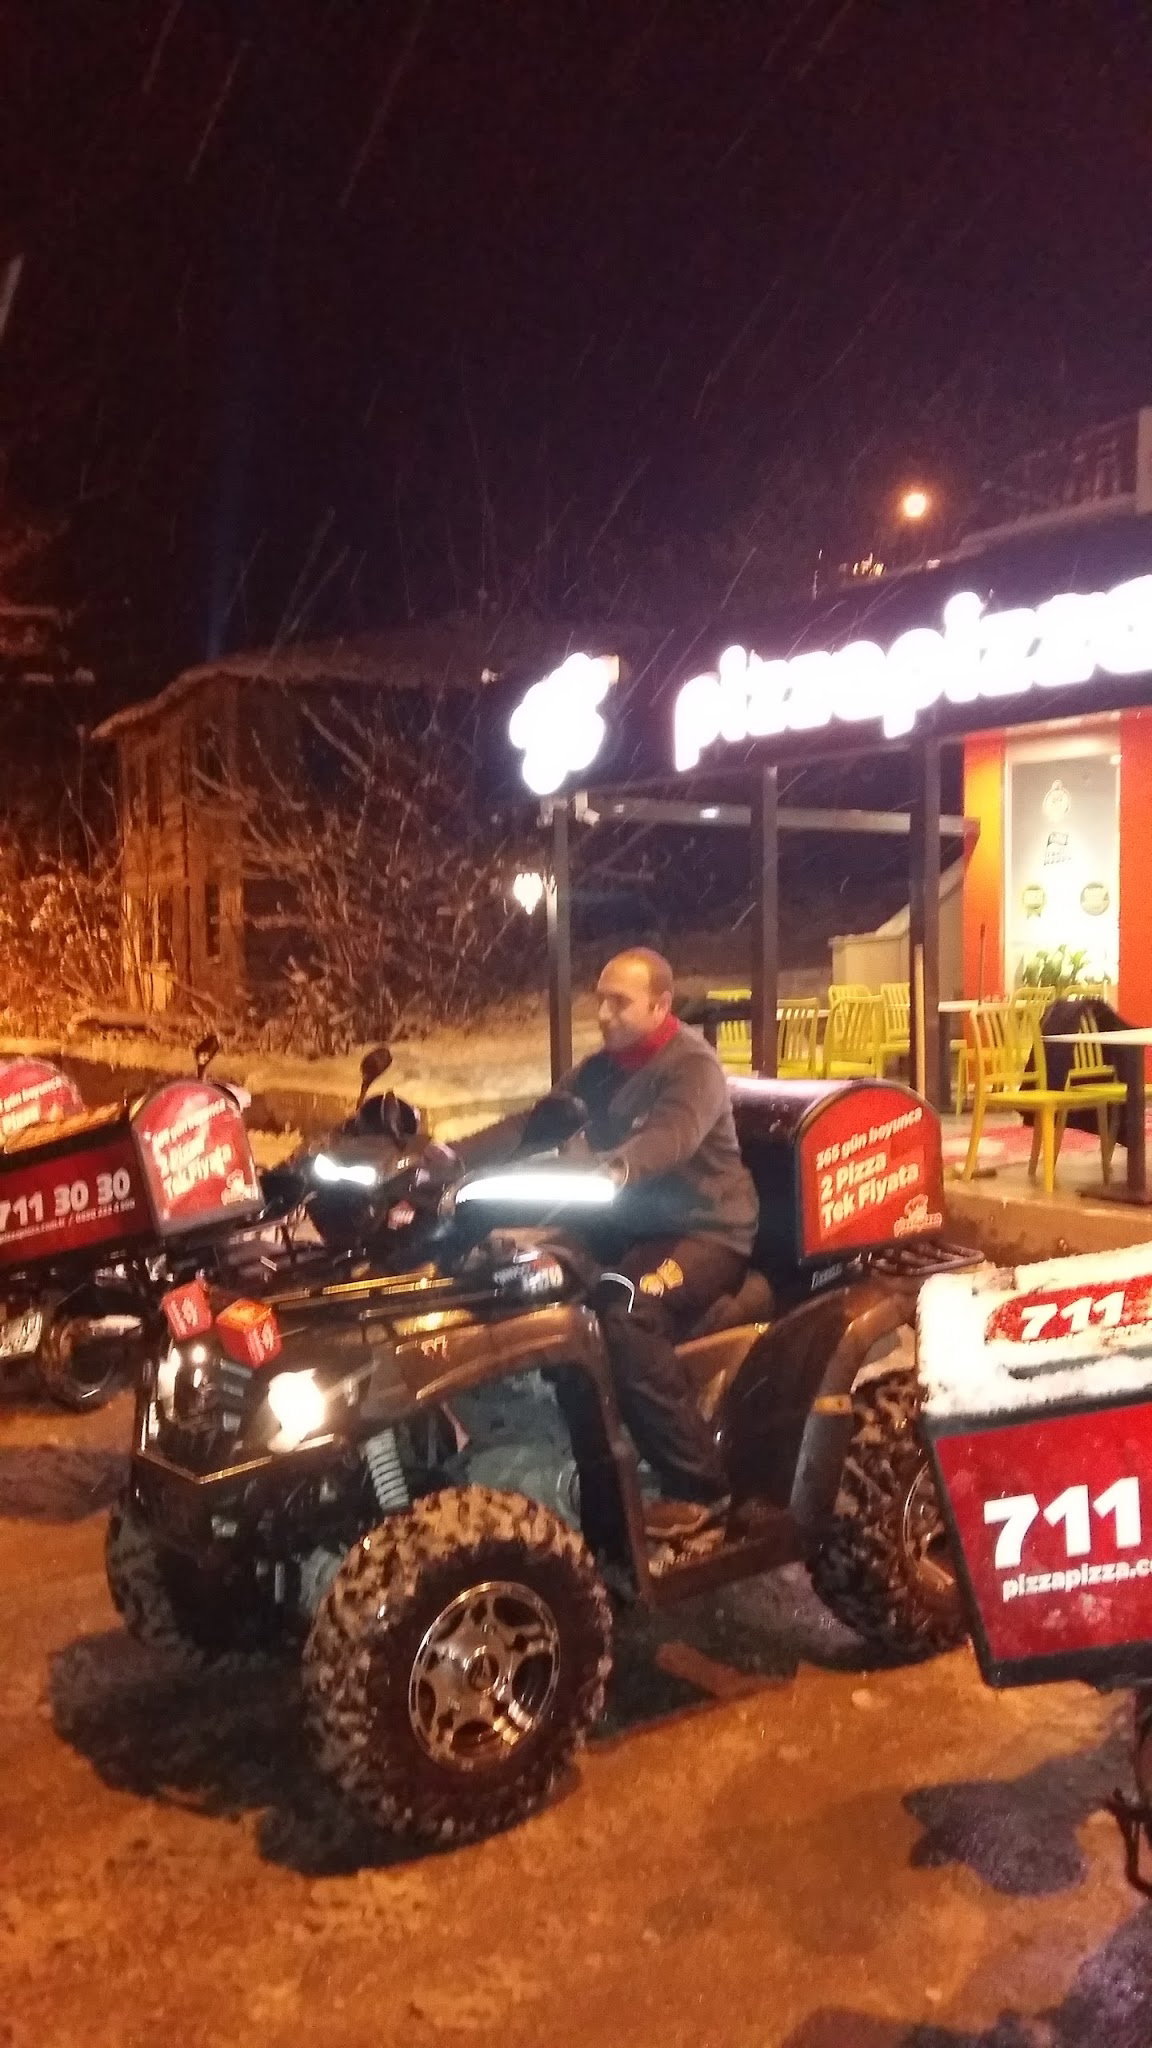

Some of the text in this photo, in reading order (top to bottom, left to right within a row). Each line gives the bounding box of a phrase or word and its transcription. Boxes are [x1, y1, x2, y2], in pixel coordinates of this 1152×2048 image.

[816, 1107, 923, 1171] 365 gün boyunca
[54, 1180, 89, 1216] 30
[96, 1168, 131, 1205] 30
[820, 1151, 887, 1202] 2 Pizza
[820, 1192, 855, 1229] Tek
[858, 1163, 920, 1211] Fiyata
[1021, 1290, 1126, 1341] 711
[984, 1476, 1142, 1570] 711
[1003, 1558, 1152, 1603] pizzapizza.c
